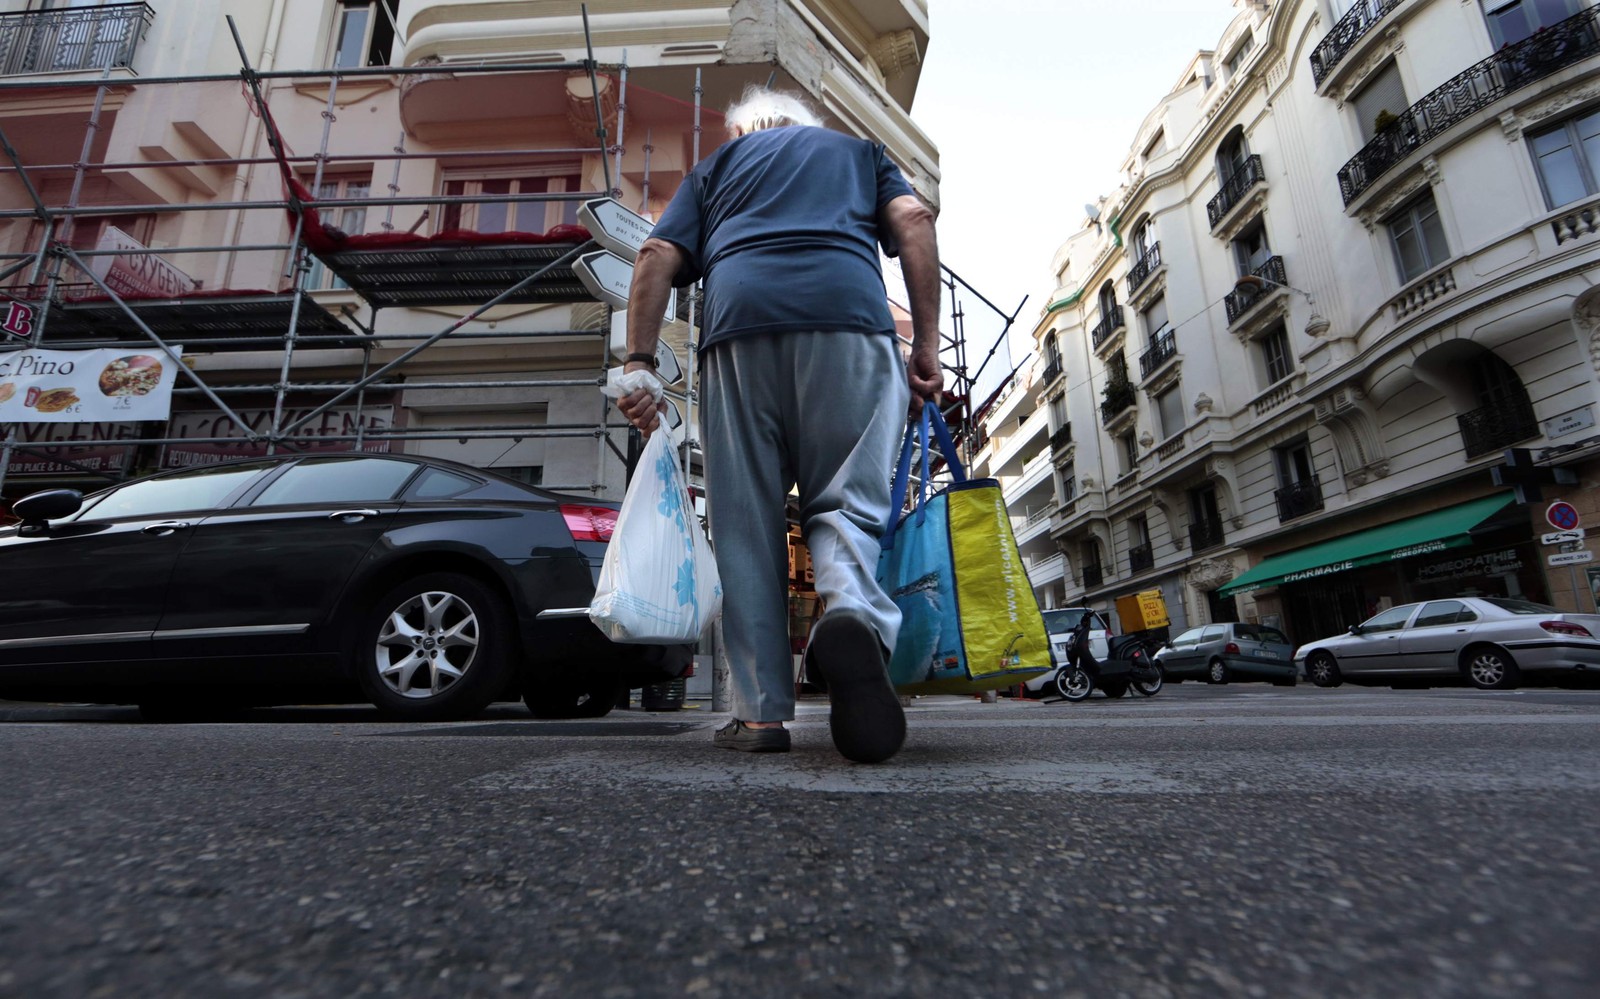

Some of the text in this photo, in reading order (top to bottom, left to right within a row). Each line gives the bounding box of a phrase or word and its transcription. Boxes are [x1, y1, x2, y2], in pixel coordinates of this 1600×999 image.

[616, 212, 639, 230] TOUTES
[616, 226, 628, 235] par
[615, 281, 627, 290] par
[8, 463, 23, 473] SUR
[23, 461, 46, 472] PLACE
[1418, 548, 1517, 577] HOMEOPATHIE
[1284, 561, 1354, 583] PHARMACIE
